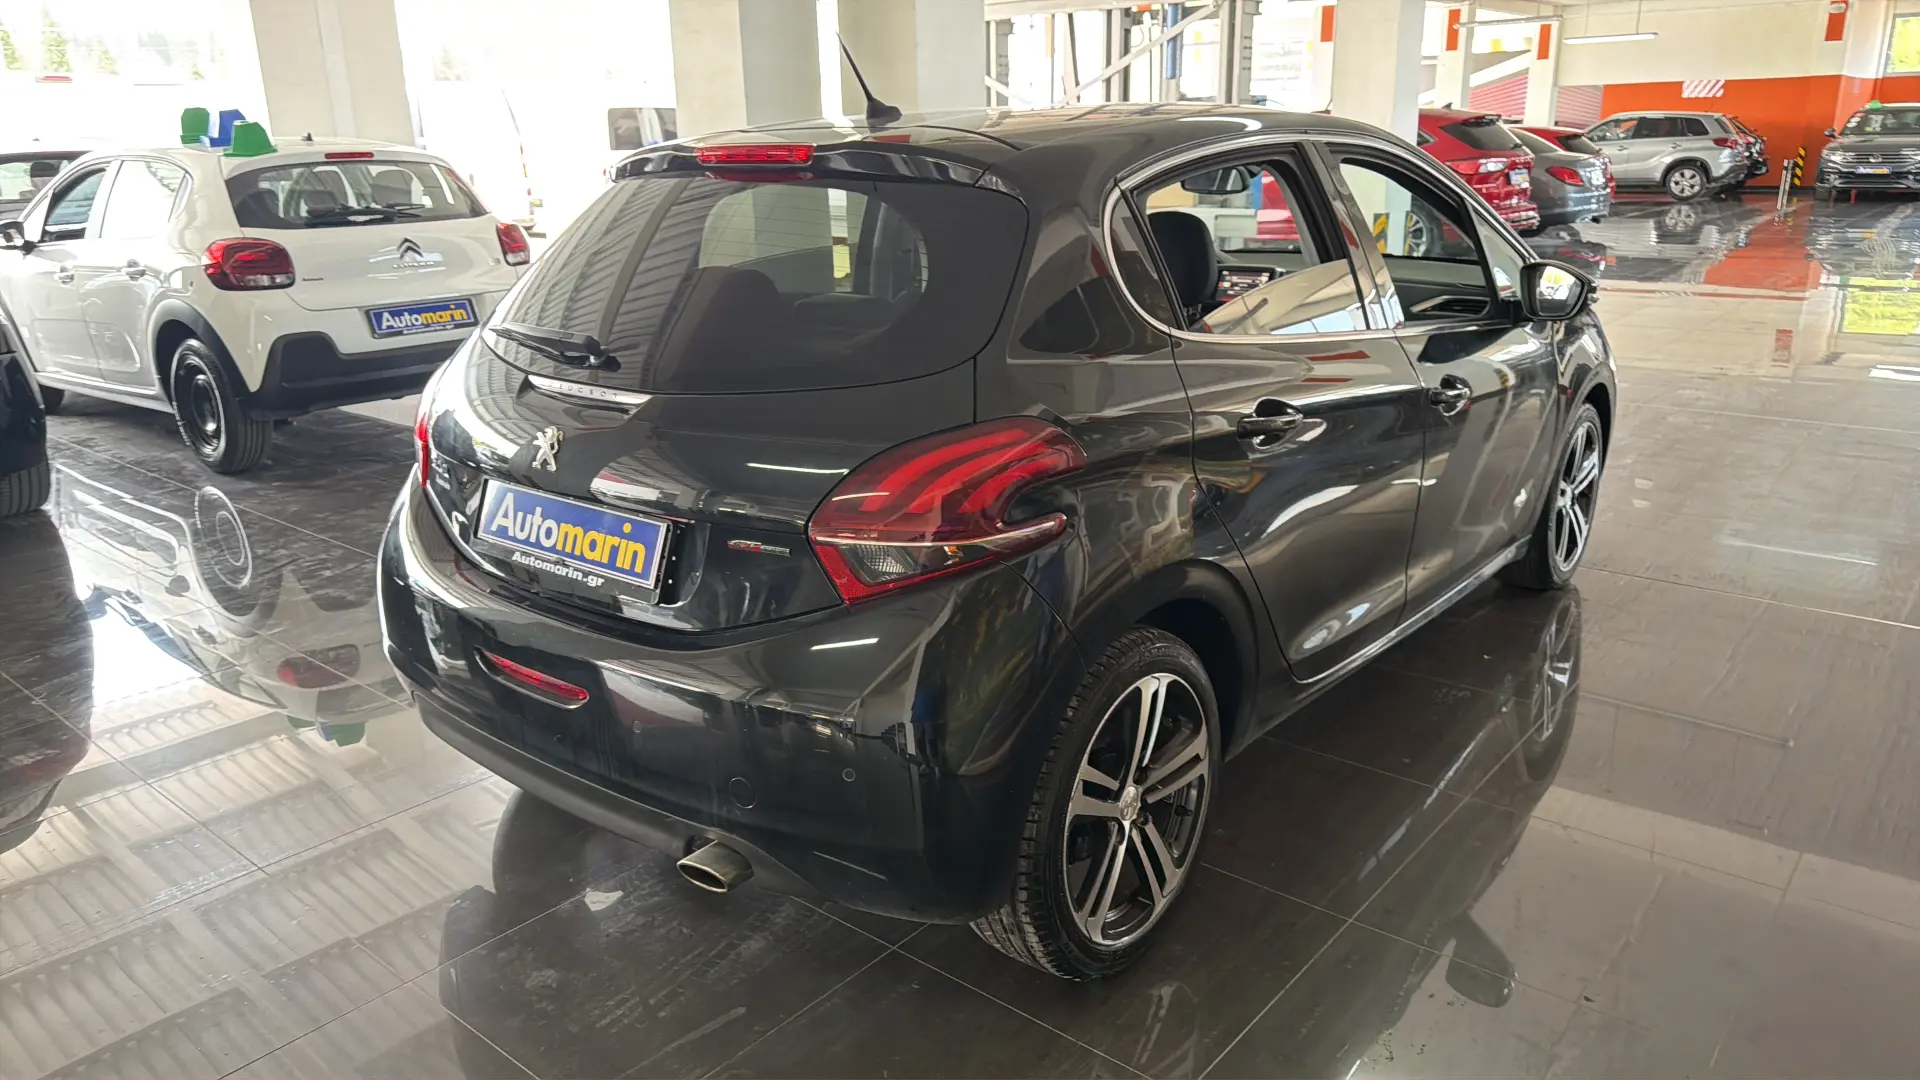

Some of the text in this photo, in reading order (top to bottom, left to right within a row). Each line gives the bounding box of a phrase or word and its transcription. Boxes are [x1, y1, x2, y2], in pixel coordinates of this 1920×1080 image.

[381, 304, 468, 330] Automarin
[547, 381, 618, 399] EUGEOT
[490, 491, 646, 574] Automarin
[511, 551, 605, 587] Automarin.gr
